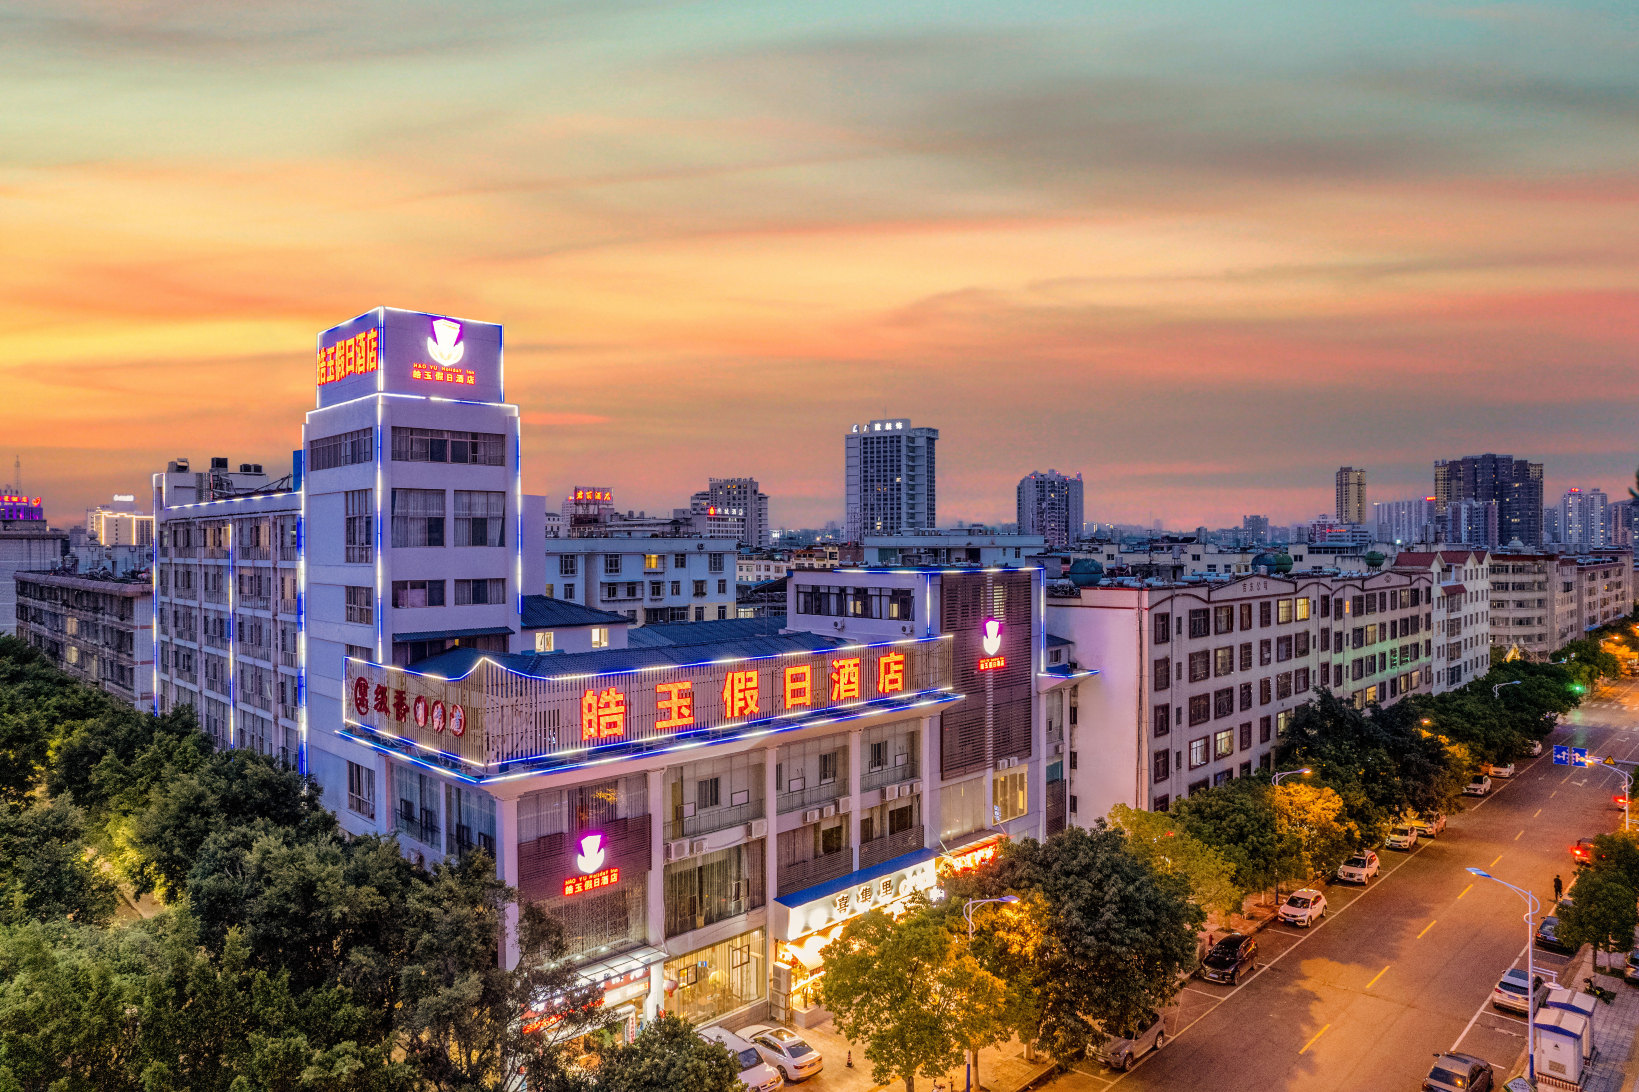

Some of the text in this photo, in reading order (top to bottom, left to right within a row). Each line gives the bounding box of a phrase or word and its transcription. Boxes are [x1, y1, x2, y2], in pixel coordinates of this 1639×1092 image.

[316, 328, 377, 385] 皓玉假日酒店
[412, 370, 475, 384] 皓玉假日酒店
[581, 652, 905, 740] 皓玉假日酒店
[565, 873, 618, 895] 皓玉假日酒店
